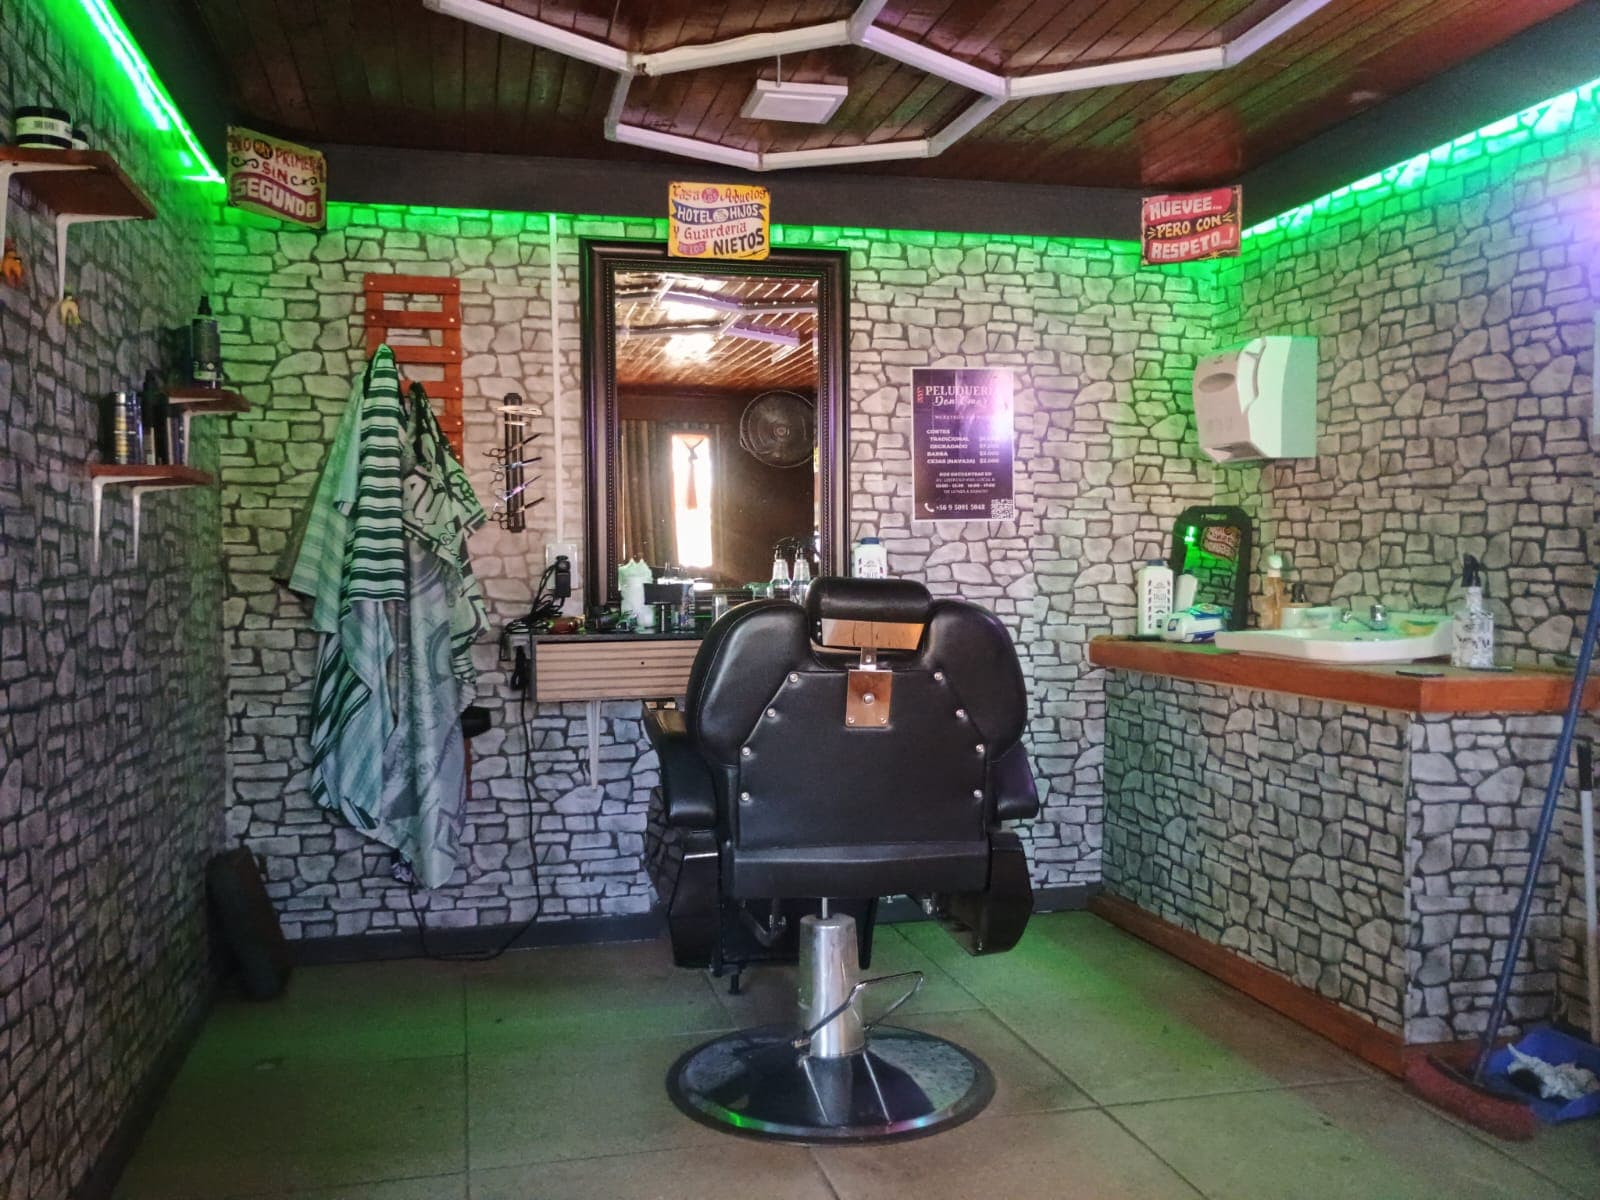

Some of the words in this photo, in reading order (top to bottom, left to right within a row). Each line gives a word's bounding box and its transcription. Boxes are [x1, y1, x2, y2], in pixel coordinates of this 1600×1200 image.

[262, 161, 289, 185] SIN
[230, 178, 317, 218] SEGUNDA
[677, 206, 713, 223] HOTEL
[729, 204, 759, 218] HIJOS
[1157, 221, 1190, 238] PERO
[1196, 215, 1222, 232] CON
[713, 228, 766, 256] NIETOS
[925, 386, 1000, 398] PELUQUERI
